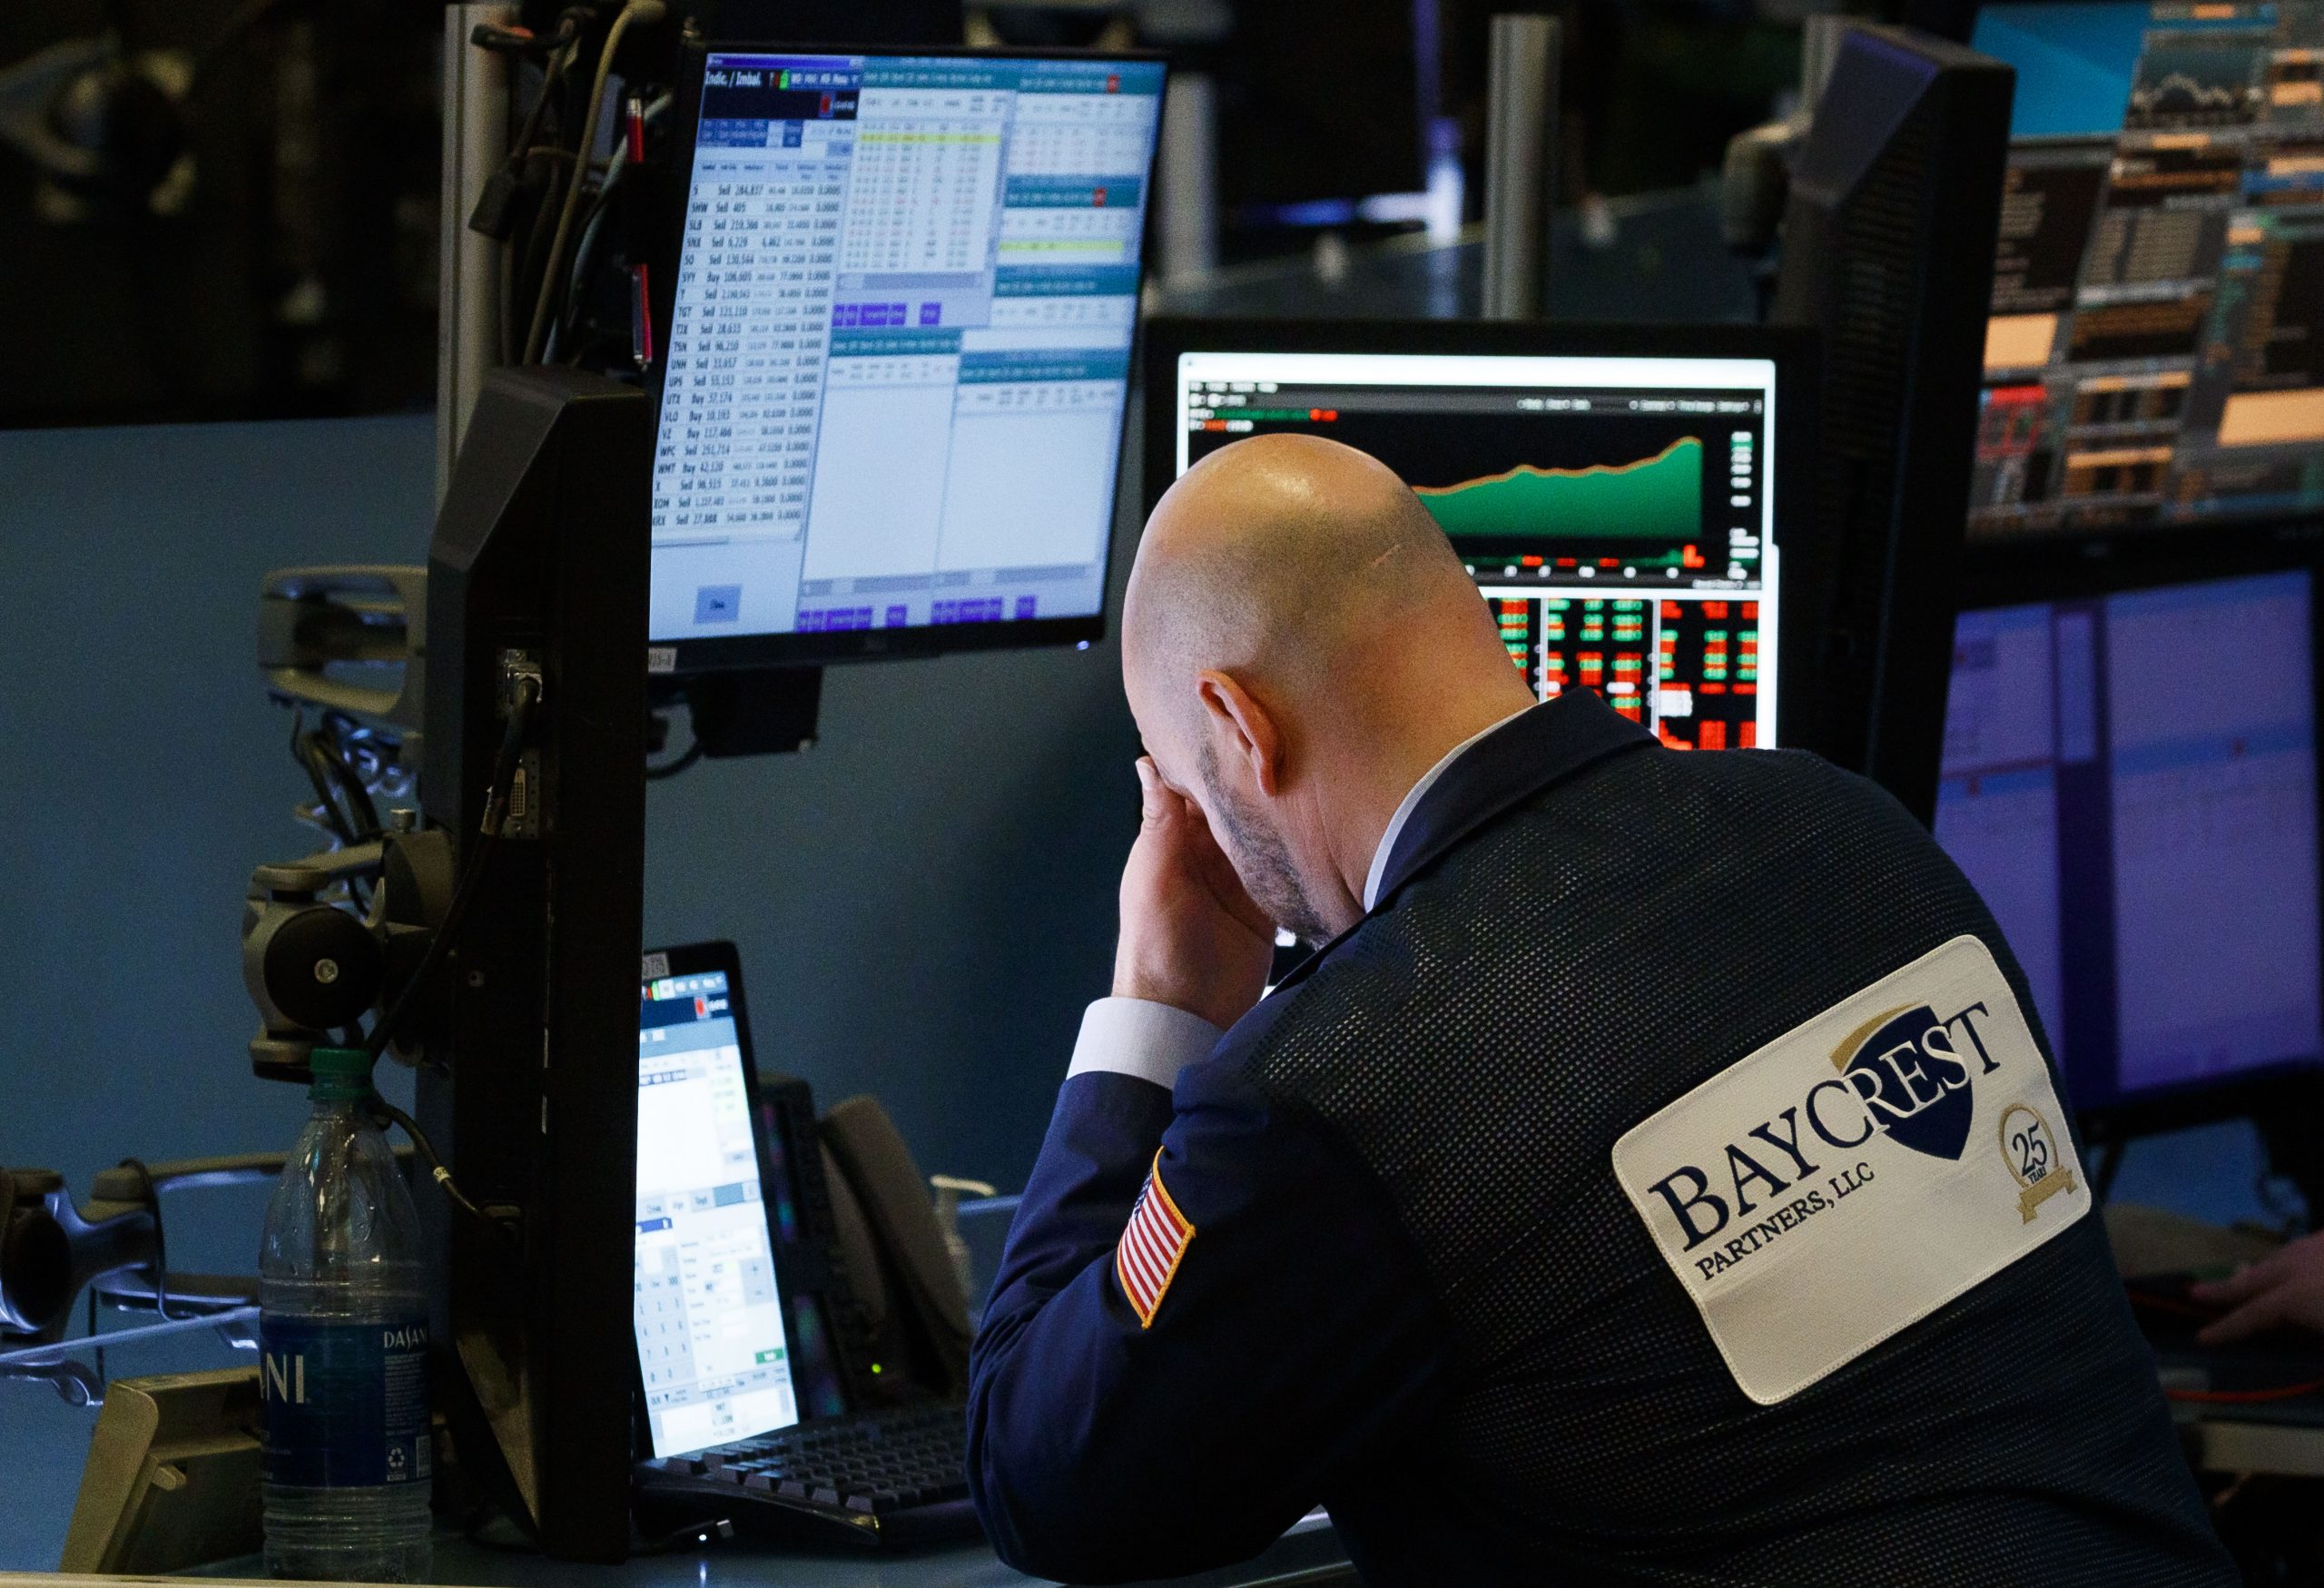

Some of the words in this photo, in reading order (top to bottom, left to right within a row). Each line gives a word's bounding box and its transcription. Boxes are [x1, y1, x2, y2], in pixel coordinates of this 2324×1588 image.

[717, 183, 732, 195] Sell
[714, 202, 730, 212] Sell
[713, 219, 727, 231] Sell
[710, 236, 725, 248] Sell
[708, 253, 723, 265] Sell
[705, 271, 722, 285] Buy
[704, 288, 718, 300] Sell
[701, 305, 716, 317] Sell
[699, 322, 714, 335] Sell
[696, 340, 712, 351] Sell
[694, 358, 710, 370] Sell
[692, 375, 707, 387] Sell
[666, 392, 681, 404] UTX
[690, 392, 705, 406] Buy
[665, 410, 679, 422] VLO
[688, 409, 704, 425] Buy
[662, 428, 672, 439] VZ
[685, 427, 701, 441] Buy
[684, 444, 699, 456] Sell
[657, 462, 676, 474] WMT
[681, 461, 697, 476] Buy
[679, 478, 694, 490] Sell
[677, 496, 692, 508] Sell
[675, 513, 690, 525] Sell
[1648, 1001, 2001, 1253] BAYCREST
[2012, 1120, 2047, 1177] 25
[1695, 1189, 1836, 1281] PARTNERS,
[1834, 1162, 1876, 1201] LLC
